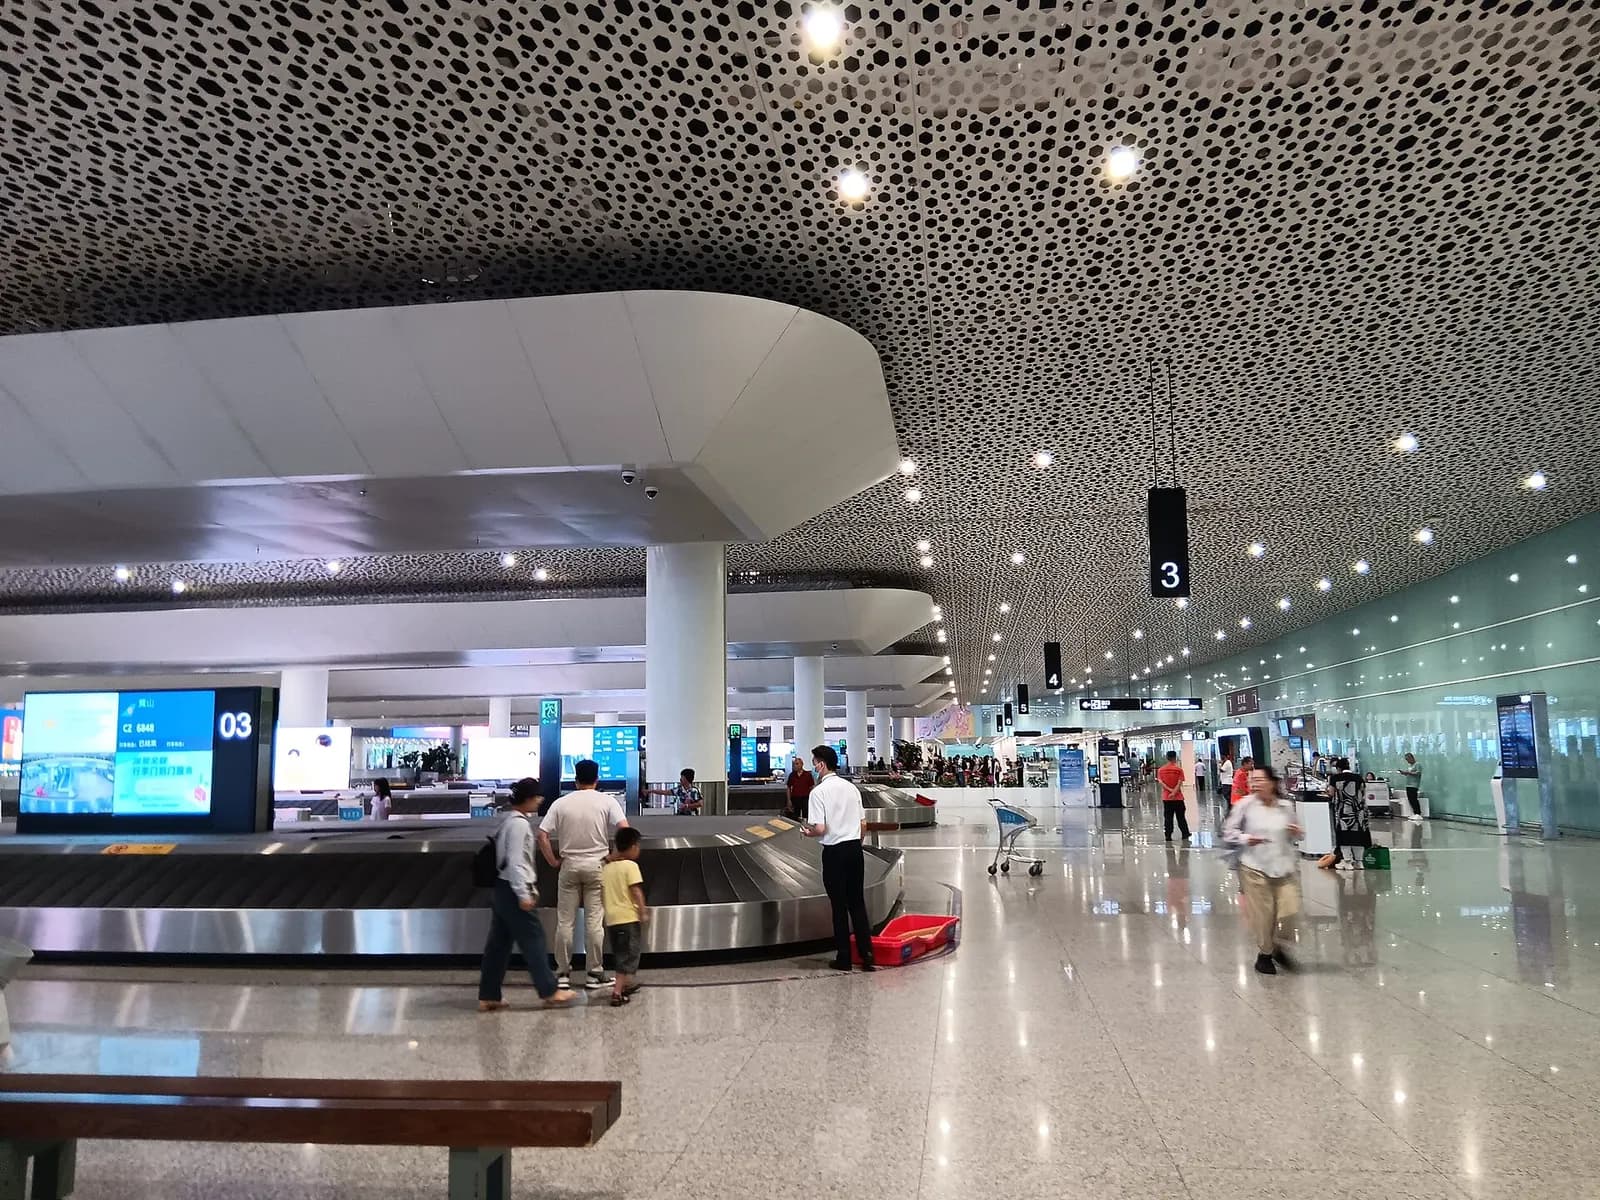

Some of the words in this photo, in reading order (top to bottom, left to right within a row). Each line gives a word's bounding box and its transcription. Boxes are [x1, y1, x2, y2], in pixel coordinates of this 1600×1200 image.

[1161, 562, 1180, 588] 3
[1049, 673, 1059, 686] 4
[1020, 704, 1027, 713] 5
[220, 712, 252, 738] 03
